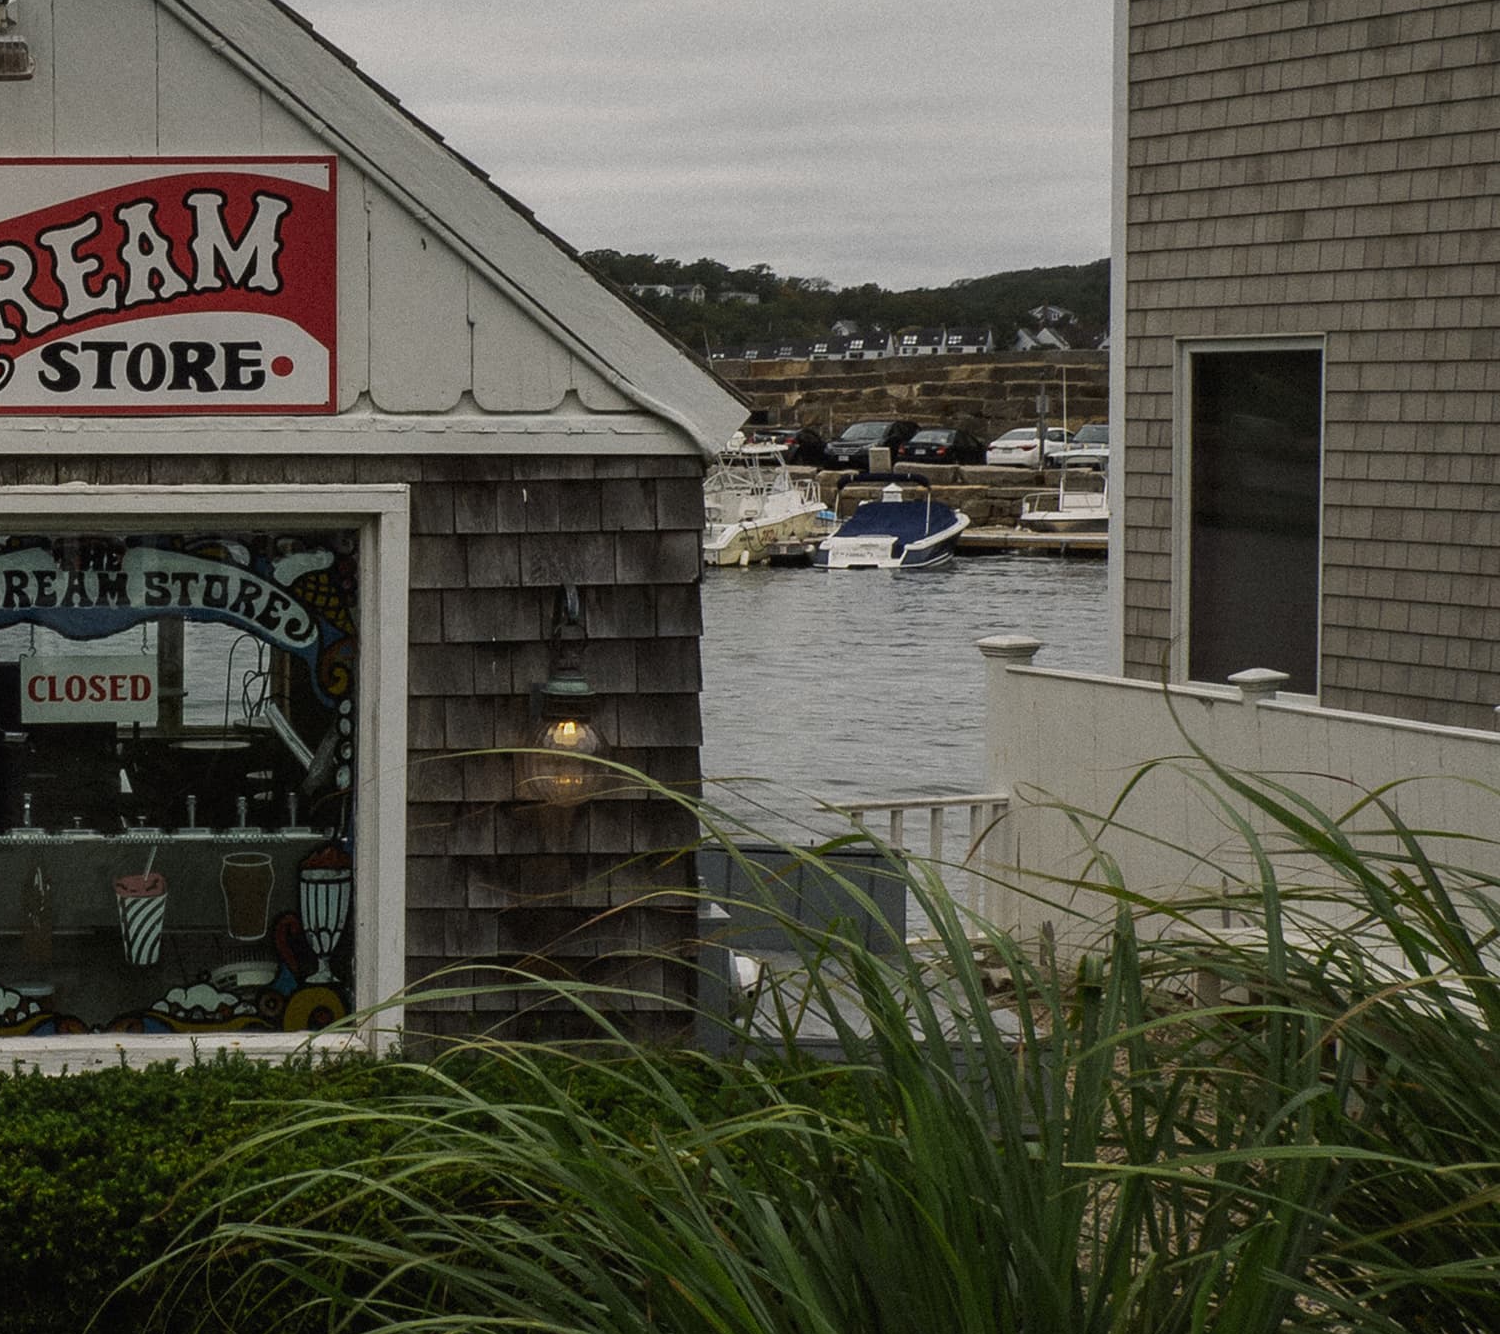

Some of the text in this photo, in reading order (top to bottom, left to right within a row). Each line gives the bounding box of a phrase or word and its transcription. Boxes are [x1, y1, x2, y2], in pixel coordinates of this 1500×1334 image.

[39, 340, 265, 393] STORE
[144, 572, 289, 631] STORE
[28, 675, 152, 702] CLOSED
